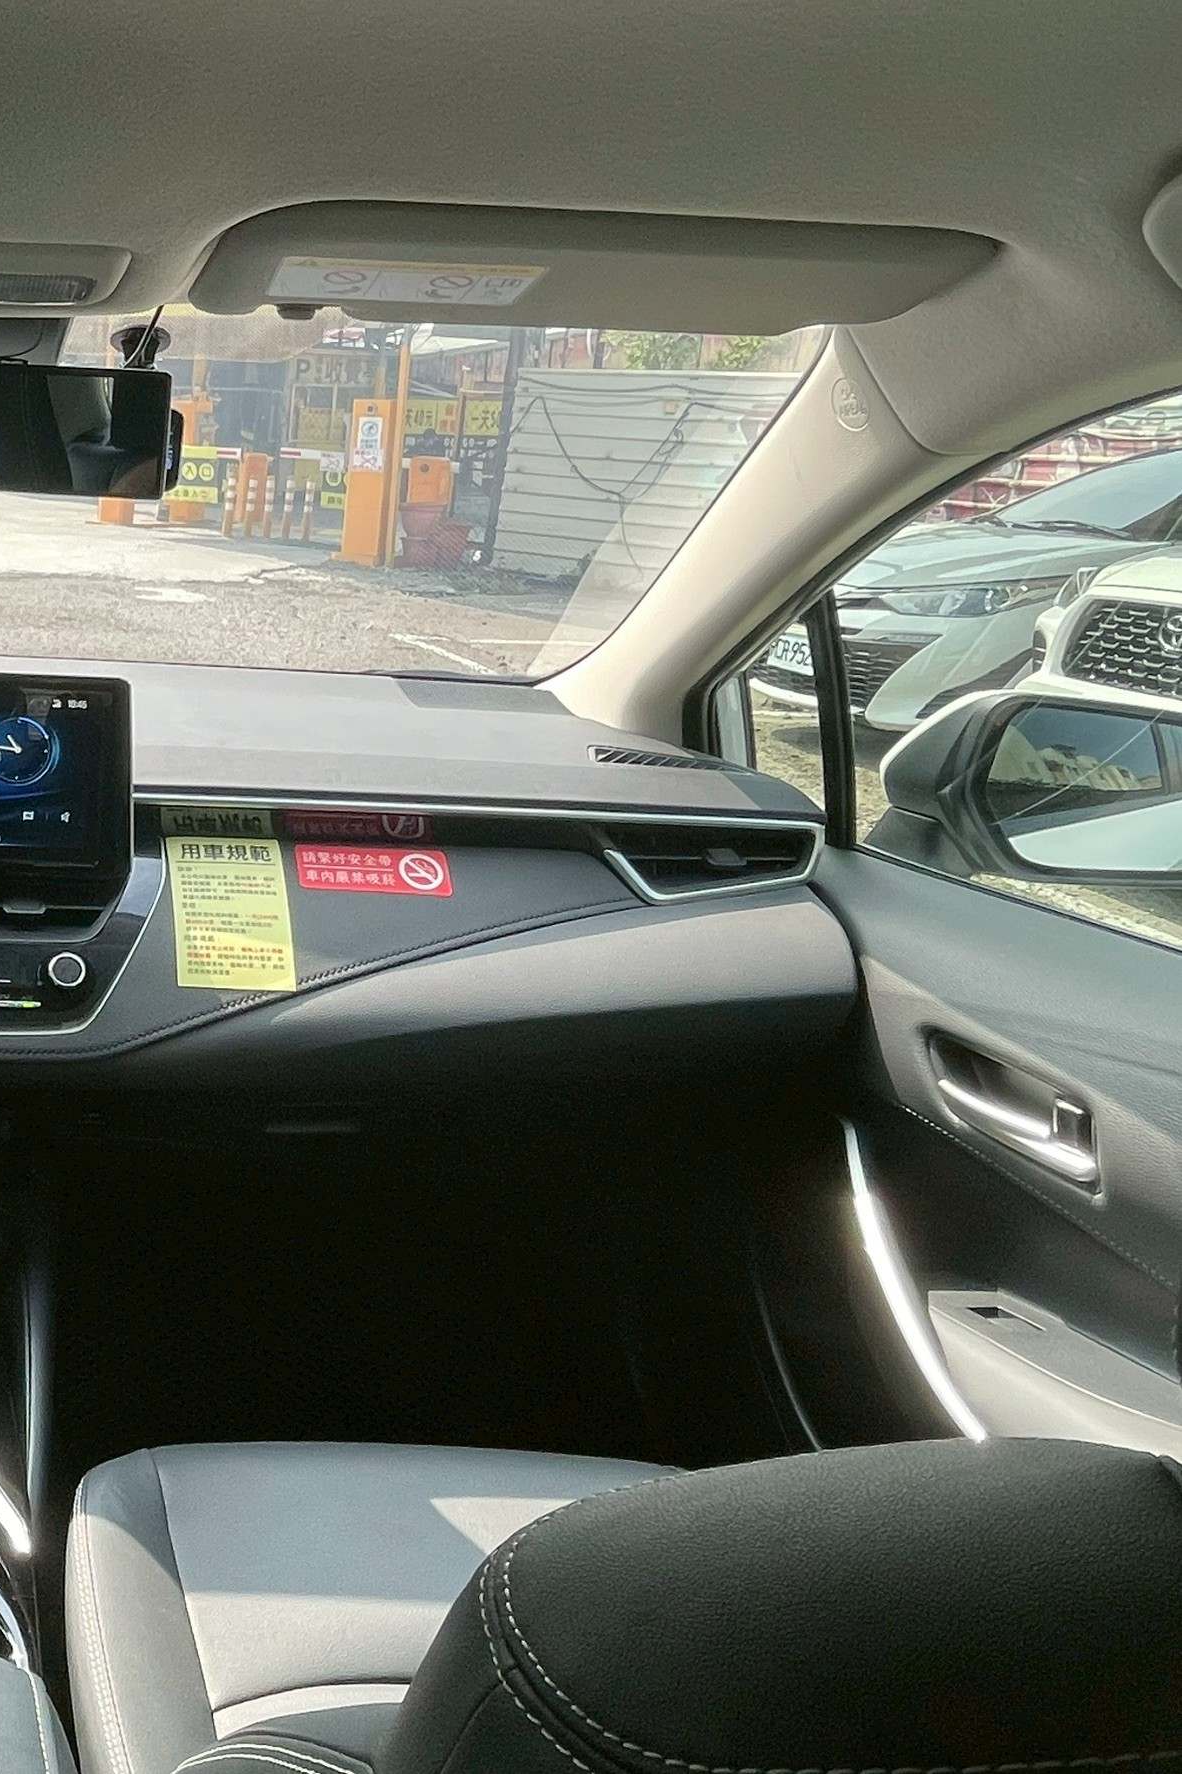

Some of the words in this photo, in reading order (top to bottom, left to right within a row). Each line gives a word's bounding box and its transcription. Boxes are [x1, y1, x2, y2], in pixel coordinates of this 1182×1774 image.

[181, 844, 271, 862] 用車規範
[302, 852, 391, 867] 請繫好安全帶
